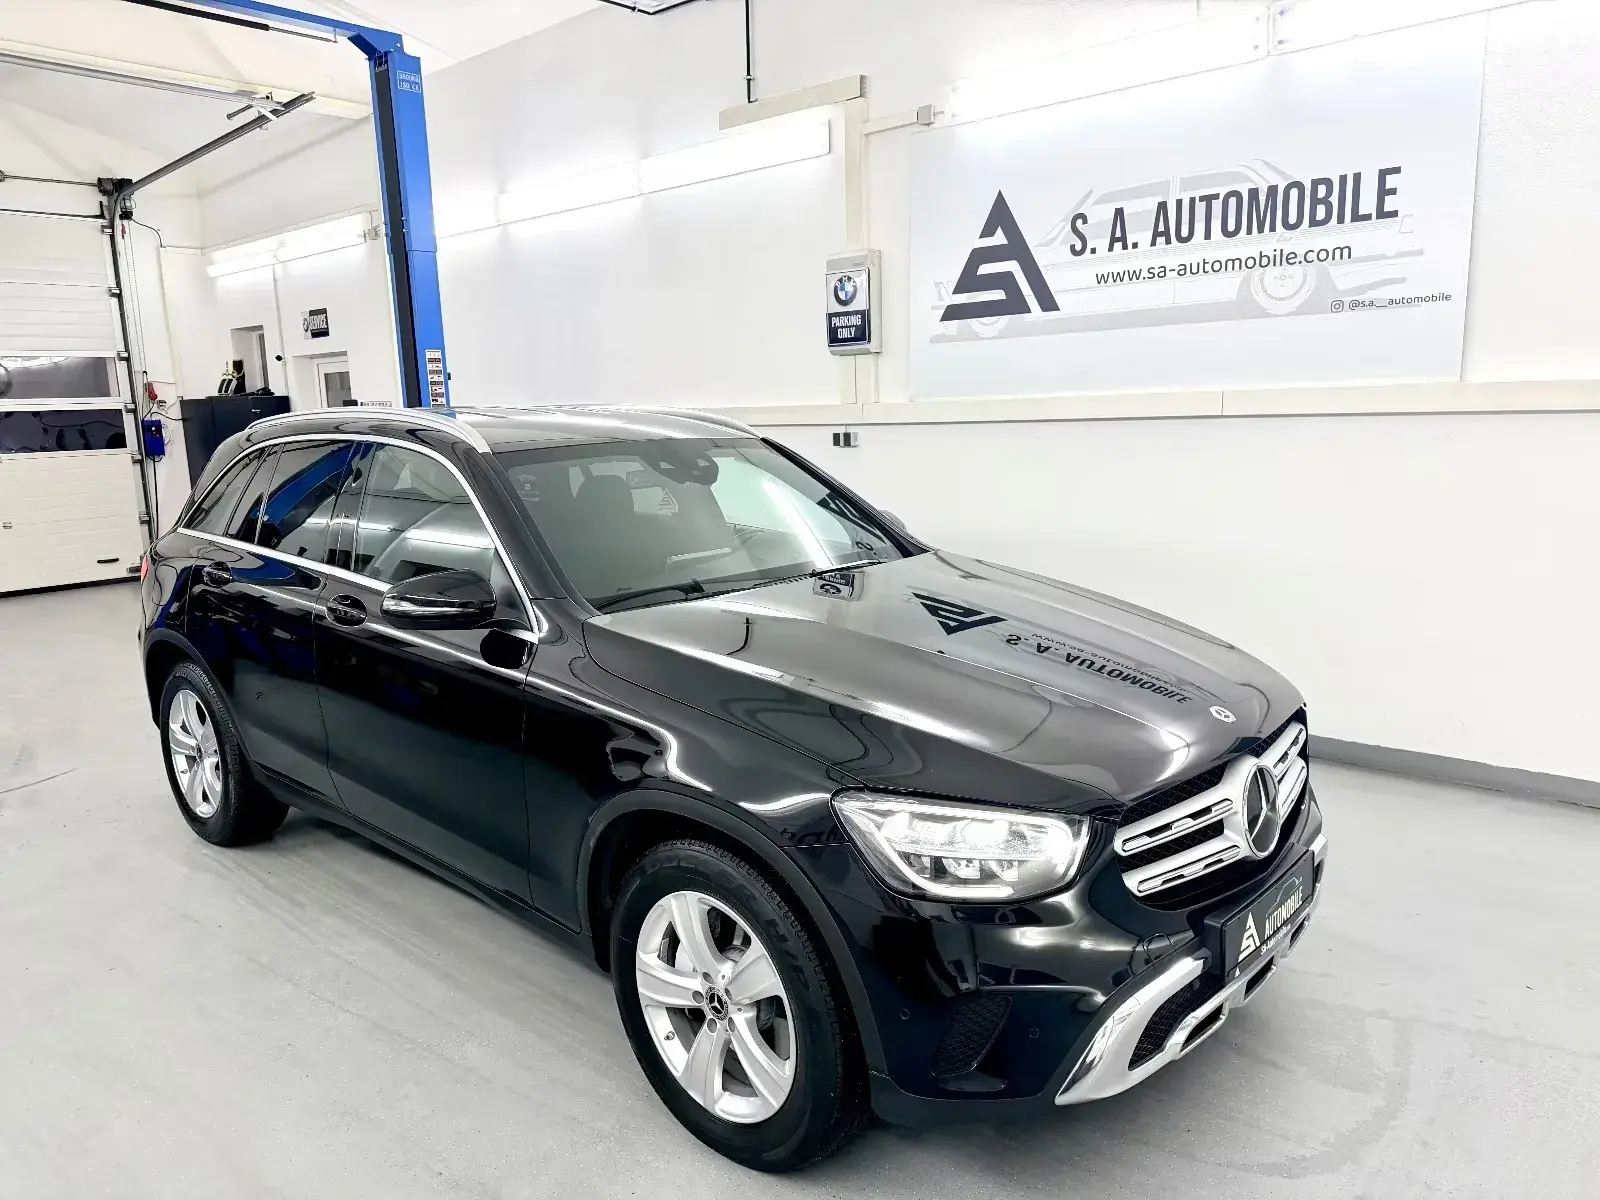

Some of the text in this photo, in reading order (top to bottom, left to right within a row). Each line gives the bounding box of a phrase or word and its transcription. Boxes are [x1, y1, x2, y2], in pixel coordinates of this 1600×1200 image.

[1069, 166, 1402, 257] S. A. AUTOMOBILE
[1095, 245, 1352, 285] www.sa-automobile.com
[831, 314, 862, 328] PARKING
[837, 327, 856, 339] ONLY
[1264, 885, 1303, 940] AUTOMOBILE
